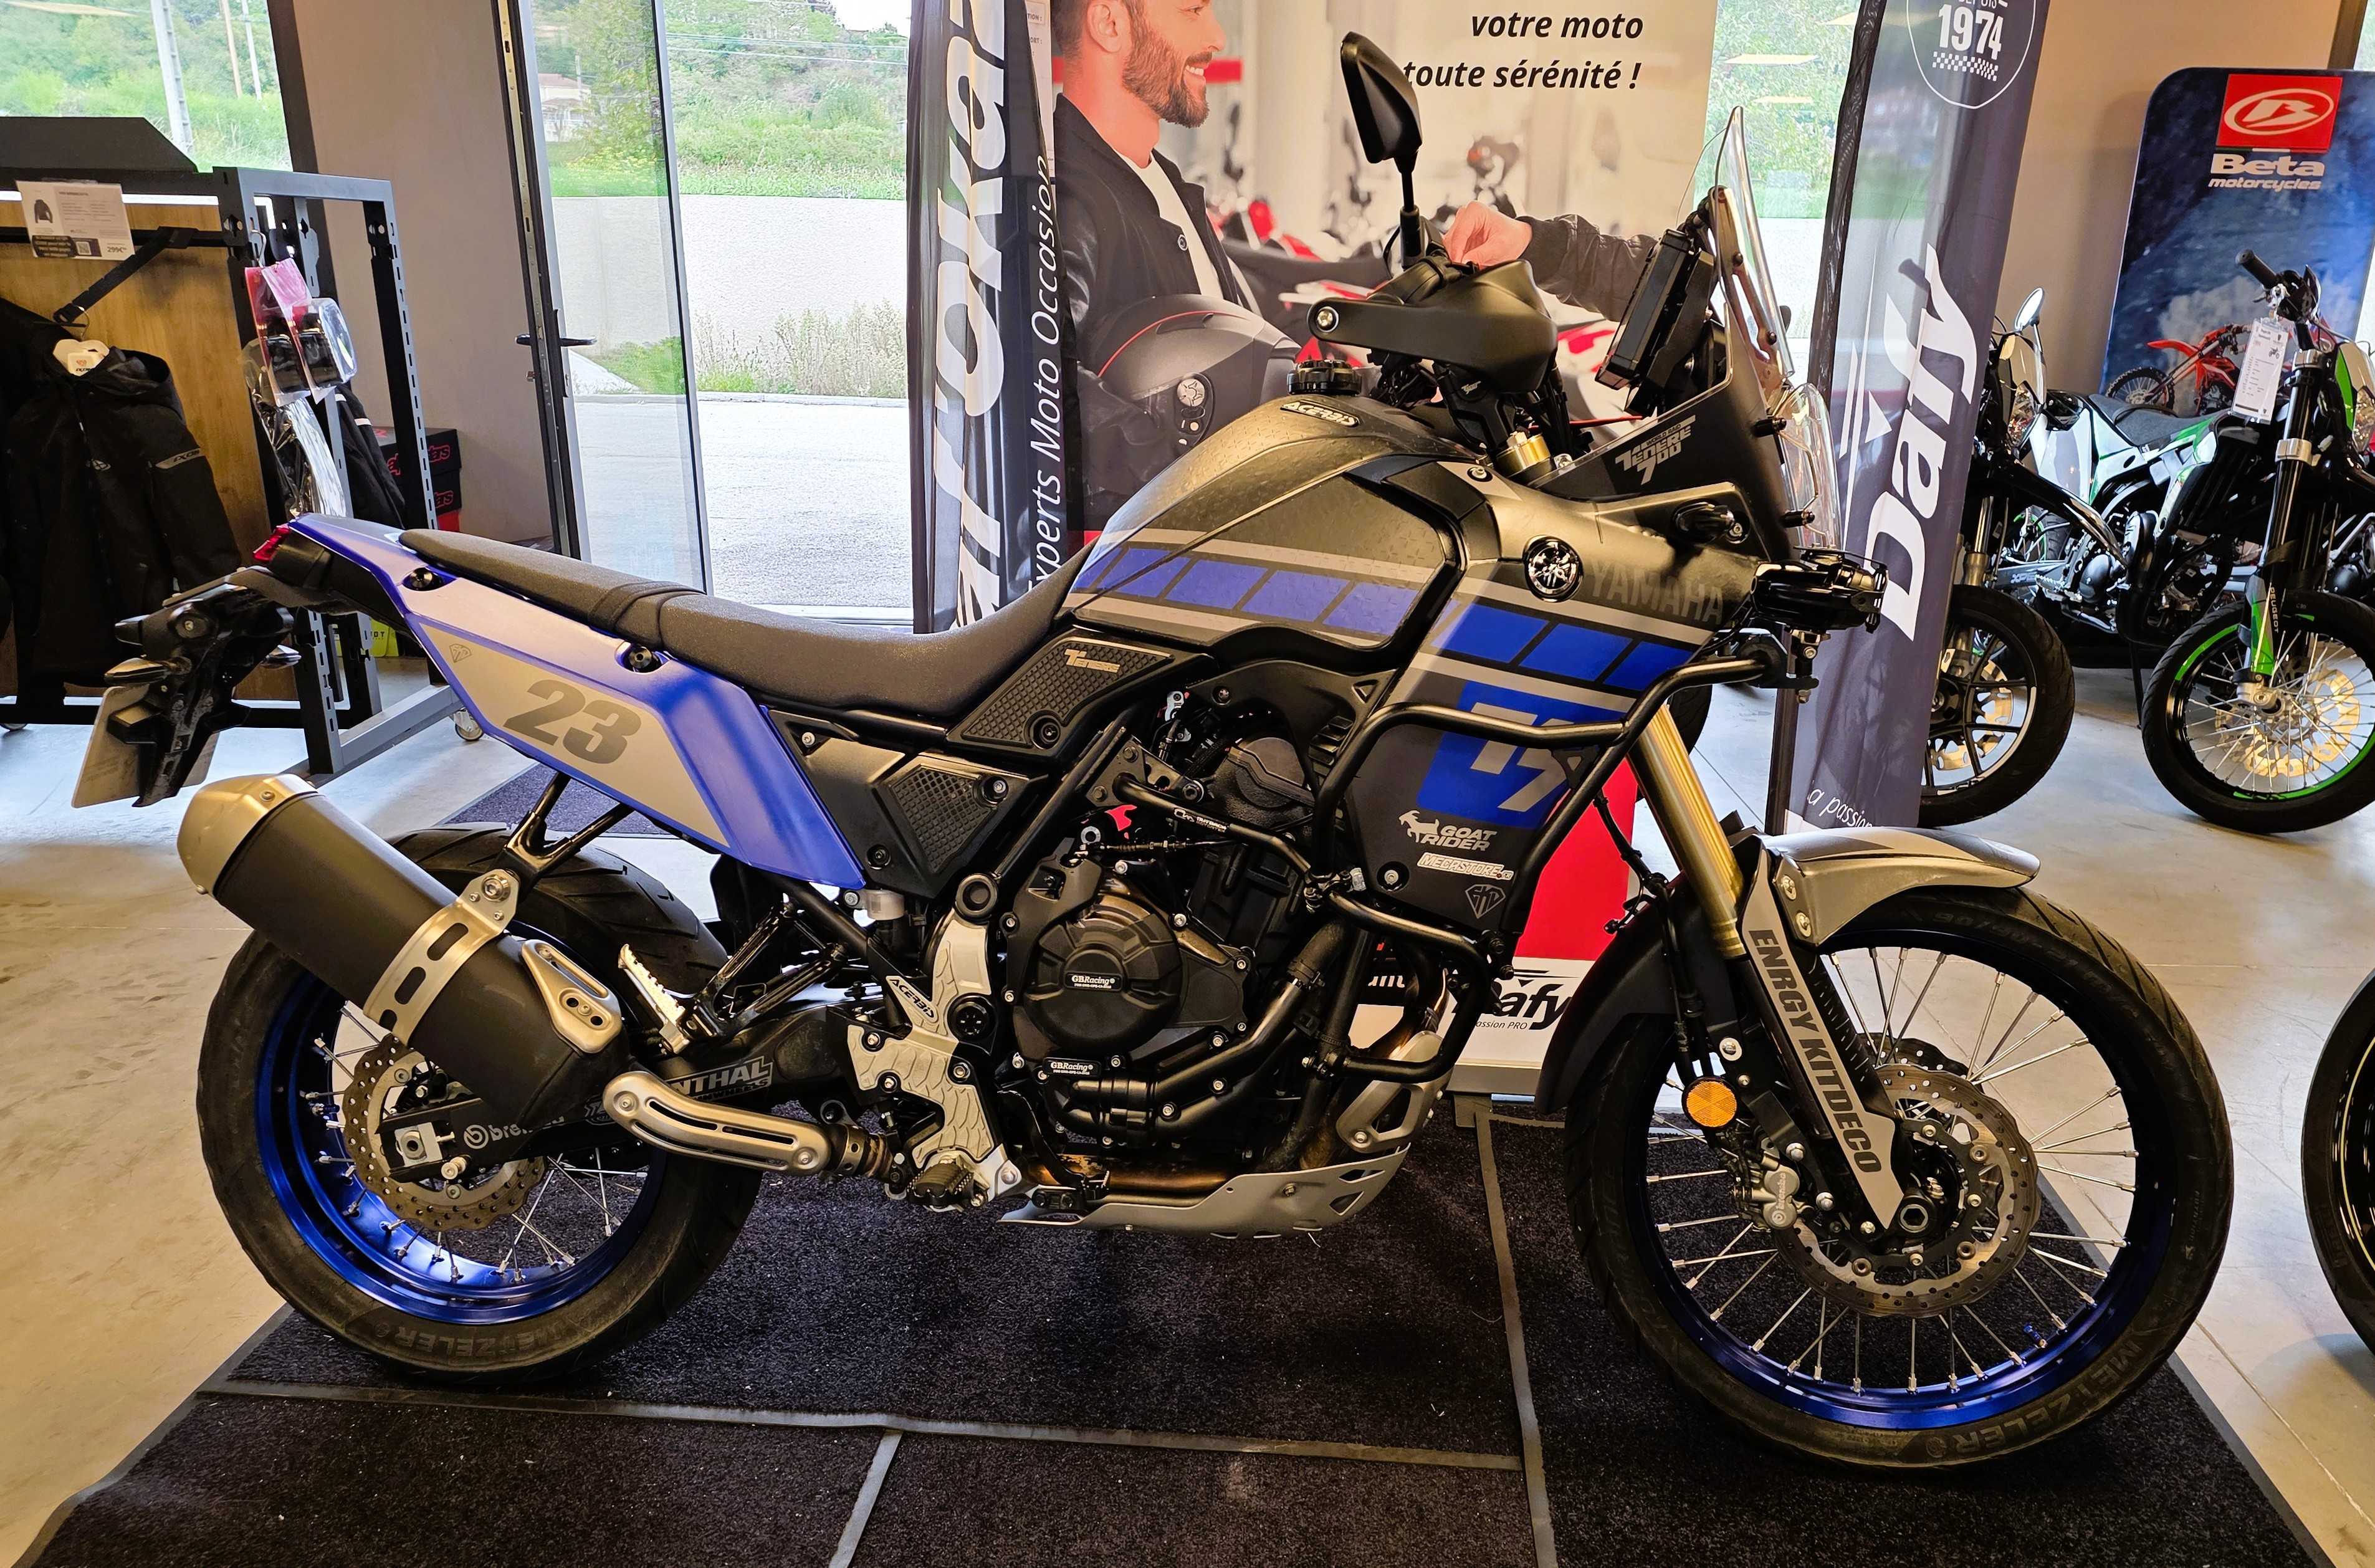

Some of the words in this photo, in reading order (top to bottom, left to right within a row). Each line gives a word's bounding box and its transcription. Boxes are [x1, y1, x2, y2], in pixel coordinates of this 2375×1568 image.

[1471, 12, 1552, 38] votre
[1560, 13, 1643, 39] moto
[1938, 4, 2004, 60] 1974
[1403, 61, 1485, 87] toute
[1493, 59, 1622, 89] sérénité
[2210, 153, 2325, 176] Beta
[2208, 177, 2321, 192] motorcycles
[1030, 155, 1059, 345] Occasion
[1030, 358, 1061, 462] Moto
[1865, 242, 1979, 643] Dafy
[1028, 471, 1063, 591] xperts
[1592, 560, 1724, 623] YAMAHA
[2269, 587, 2279, 633] PEUGEOT
[502, 679, 642, 764] 23
[1807, 786, 1825, 806] a
[1420, 833, 1491, 851] RIDER
[1440, 825, 1498, 841] GOAT
[1476, 1020, 1506, 1029] assion
[1507, 1021, 1528, 1030] PRO
[1748, 929, 1819, 1035] ENRGY
[1798, 1038, 1882, 1173] KITDECO
[671, 1061, 768, 1095] NTHAL
[488, 1116, 565, 1141] bre
